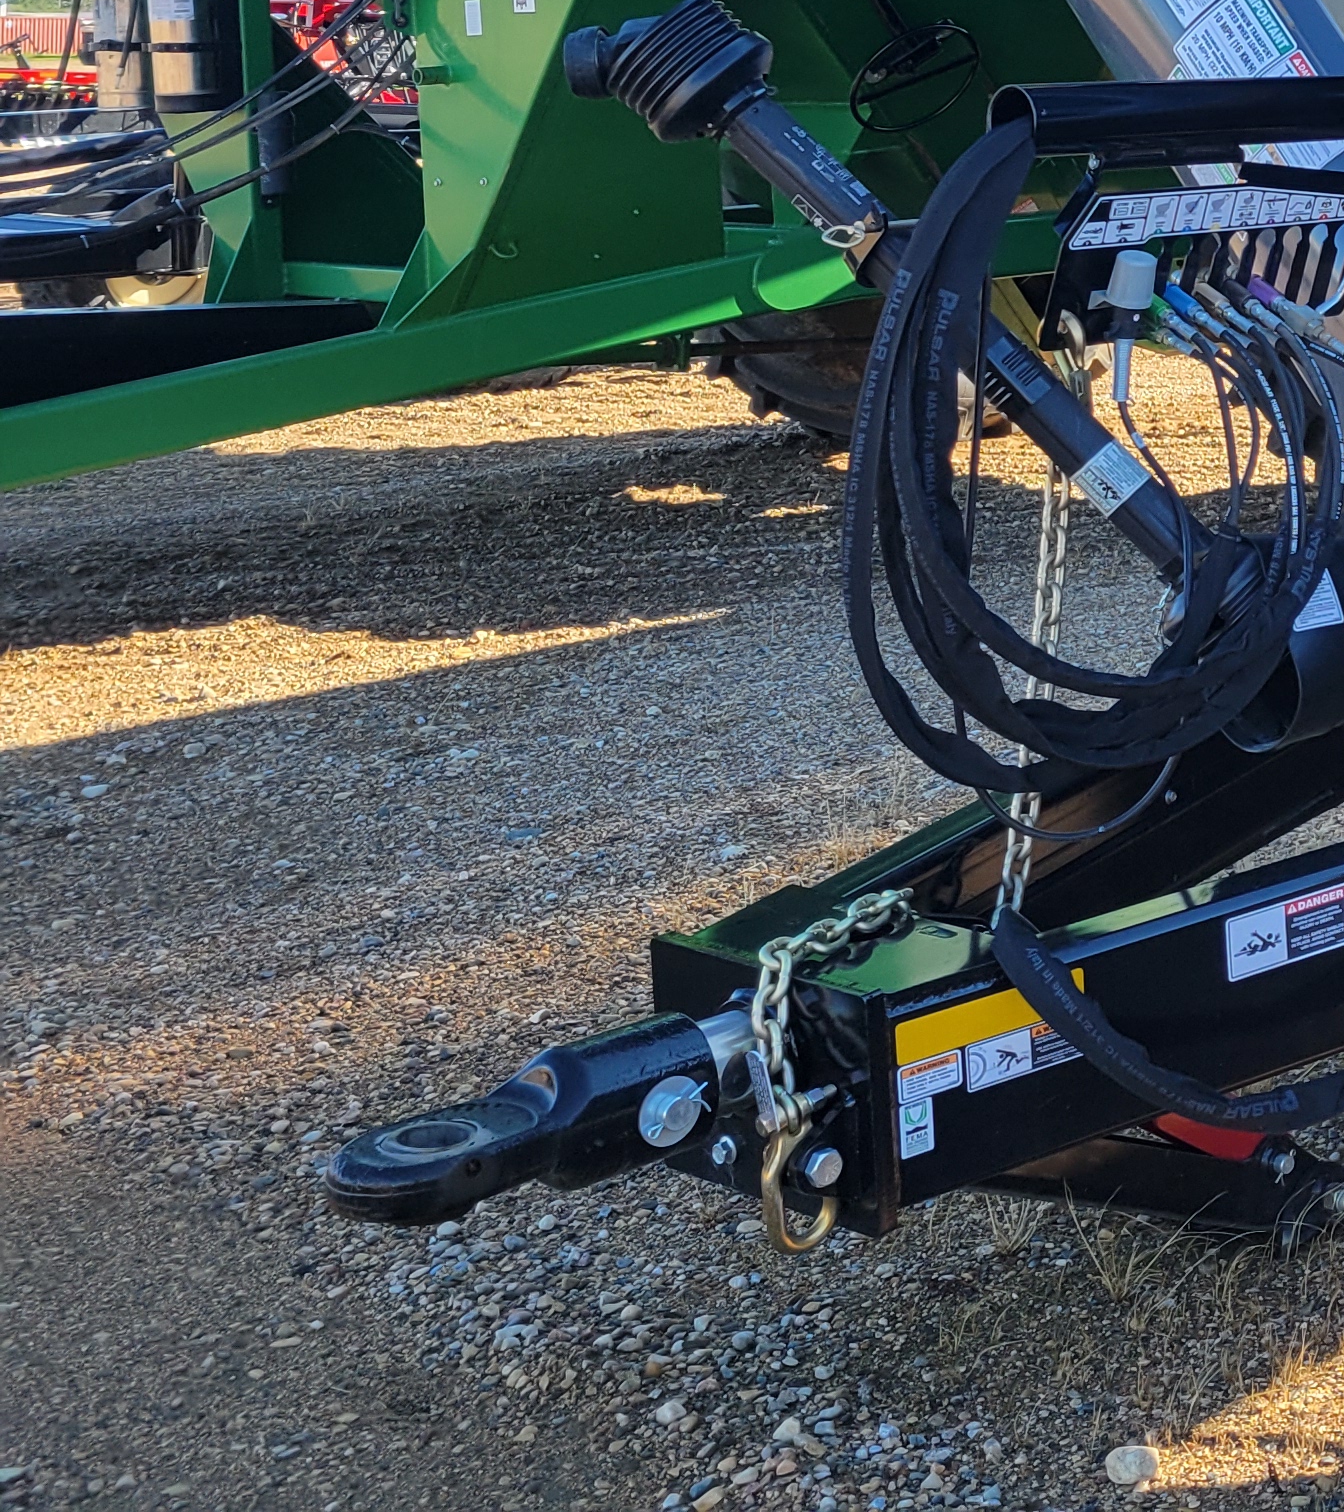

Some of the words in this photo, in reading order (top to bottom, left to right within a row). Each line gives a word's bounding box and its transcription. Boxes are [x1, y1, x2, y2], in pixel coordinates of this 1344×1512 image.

[1213, 12, 1223, 22] 10
[1219, 22, 1234, 39] MPH
[1230, 39, 1243, 53] (16
[1225, 5, 1238, 23] SPEED
[1237, 23, 1249, 40] WHEN
[1197, 44, 1211, 60] MPH
[1250, 27, 1272, 58] TRANSPORT
[874, 268, 914, 362] PULSAR
[927, 288, 961, 382] PULSAR
[859, 370, 879, 428] NAS-178
[852, 433, 867, 473] MSHA
[850, 477, 862, 492] IC
[1296, 888, 1344, 910] DANGER
[1021, 944, 1046, 972] Italy
[1038, 968, 1053, 984] in
[1048, 981, 1077, 1015] Made
[915, 1057, 950, 1072] WARNING
[1102, 1044, 1118, 1059] IC
[1222, 1091, 1298, 1120] PULSAR
[905, 1131, 927, 1142] FEMA
